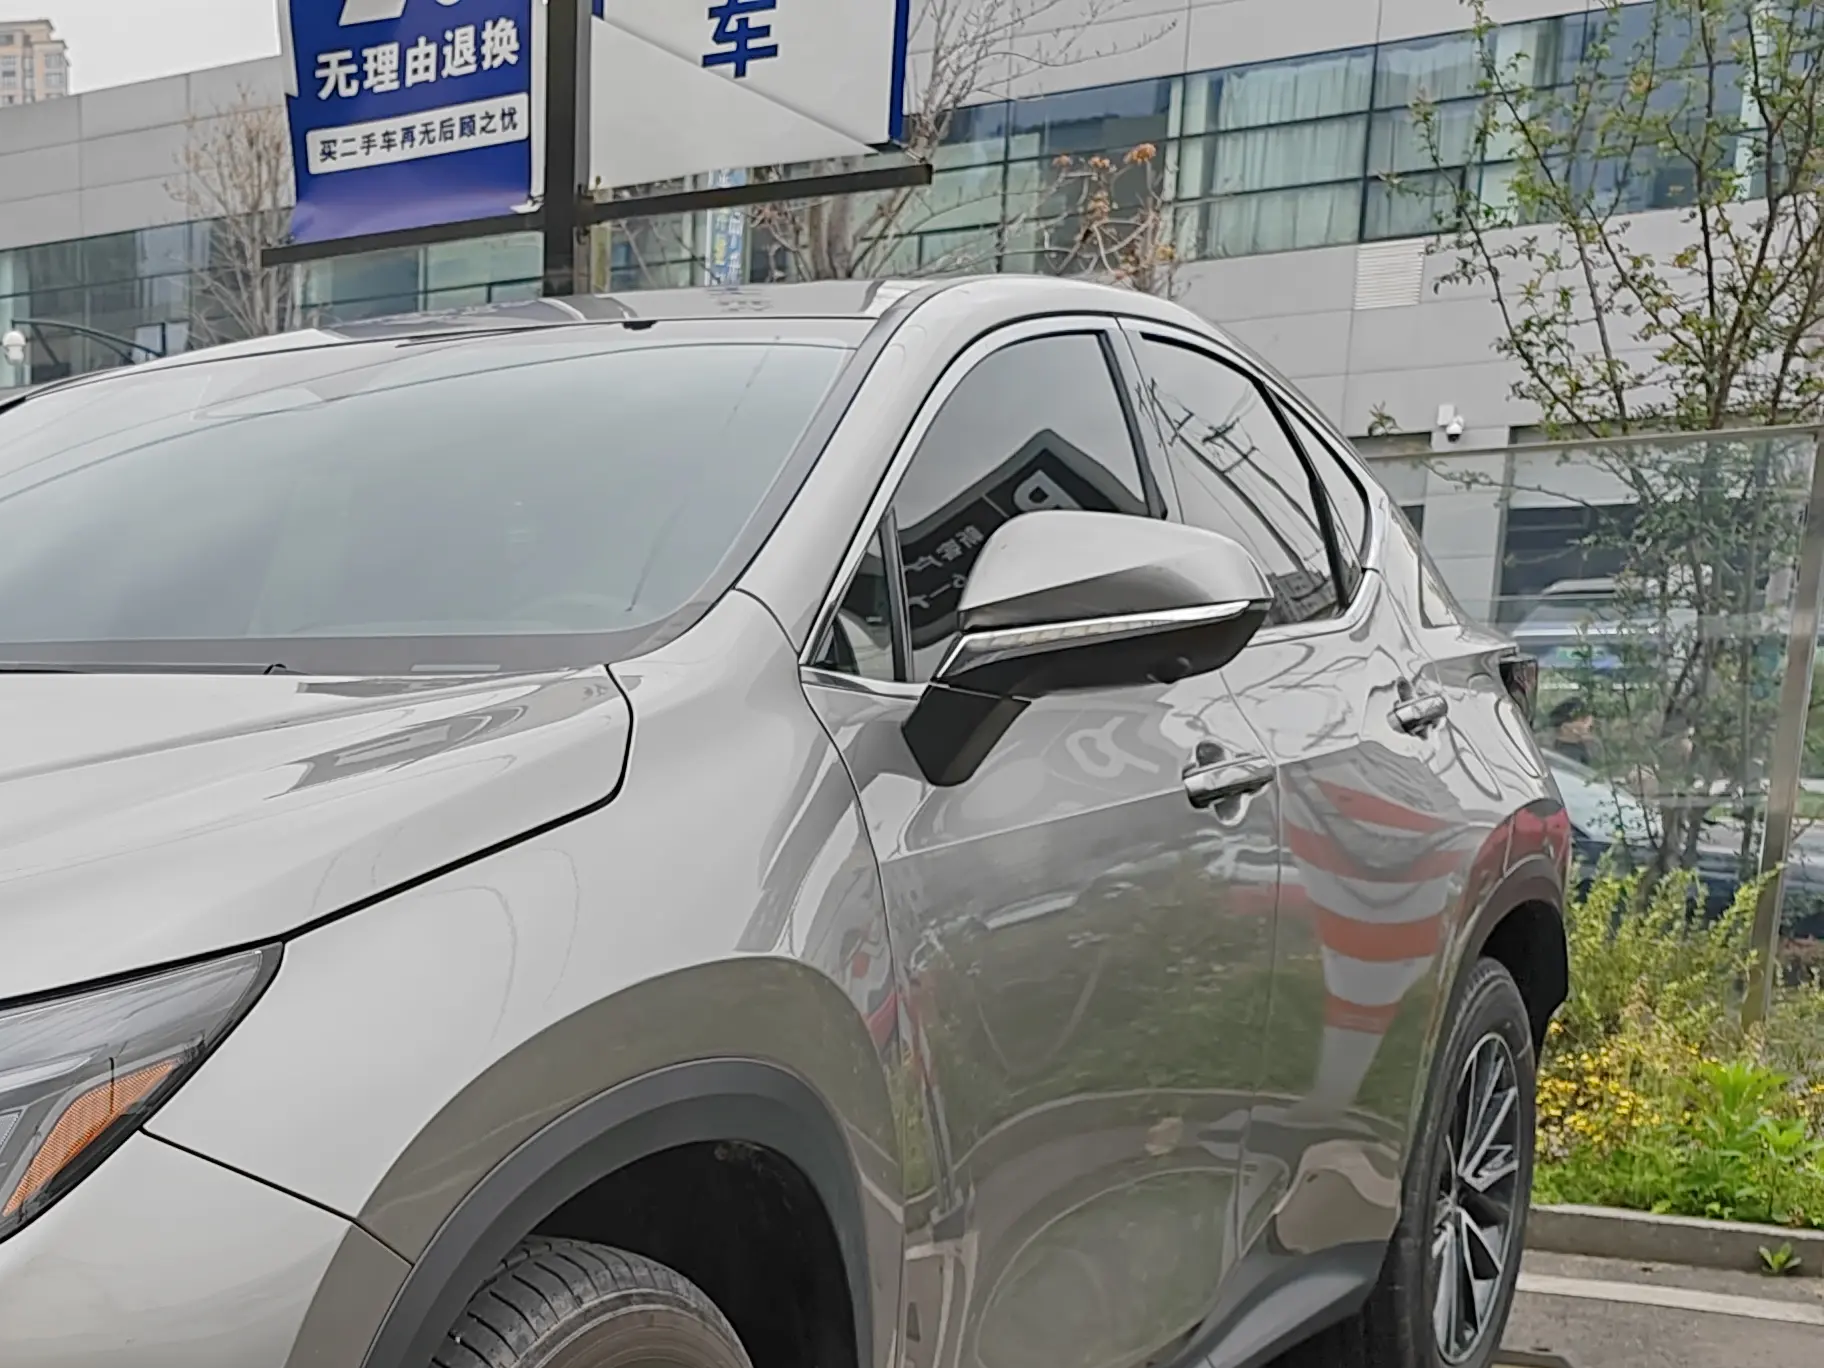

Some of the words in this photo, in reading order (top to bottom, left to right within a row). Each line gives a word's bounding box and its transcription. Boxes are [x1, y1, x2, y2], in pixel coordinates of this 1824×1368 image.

[315, 17, 520, 100] 无理由退换
[702, 0, 778, 79] 车
[320, 107, 518, 163] 买二手车再无后顾之忧
